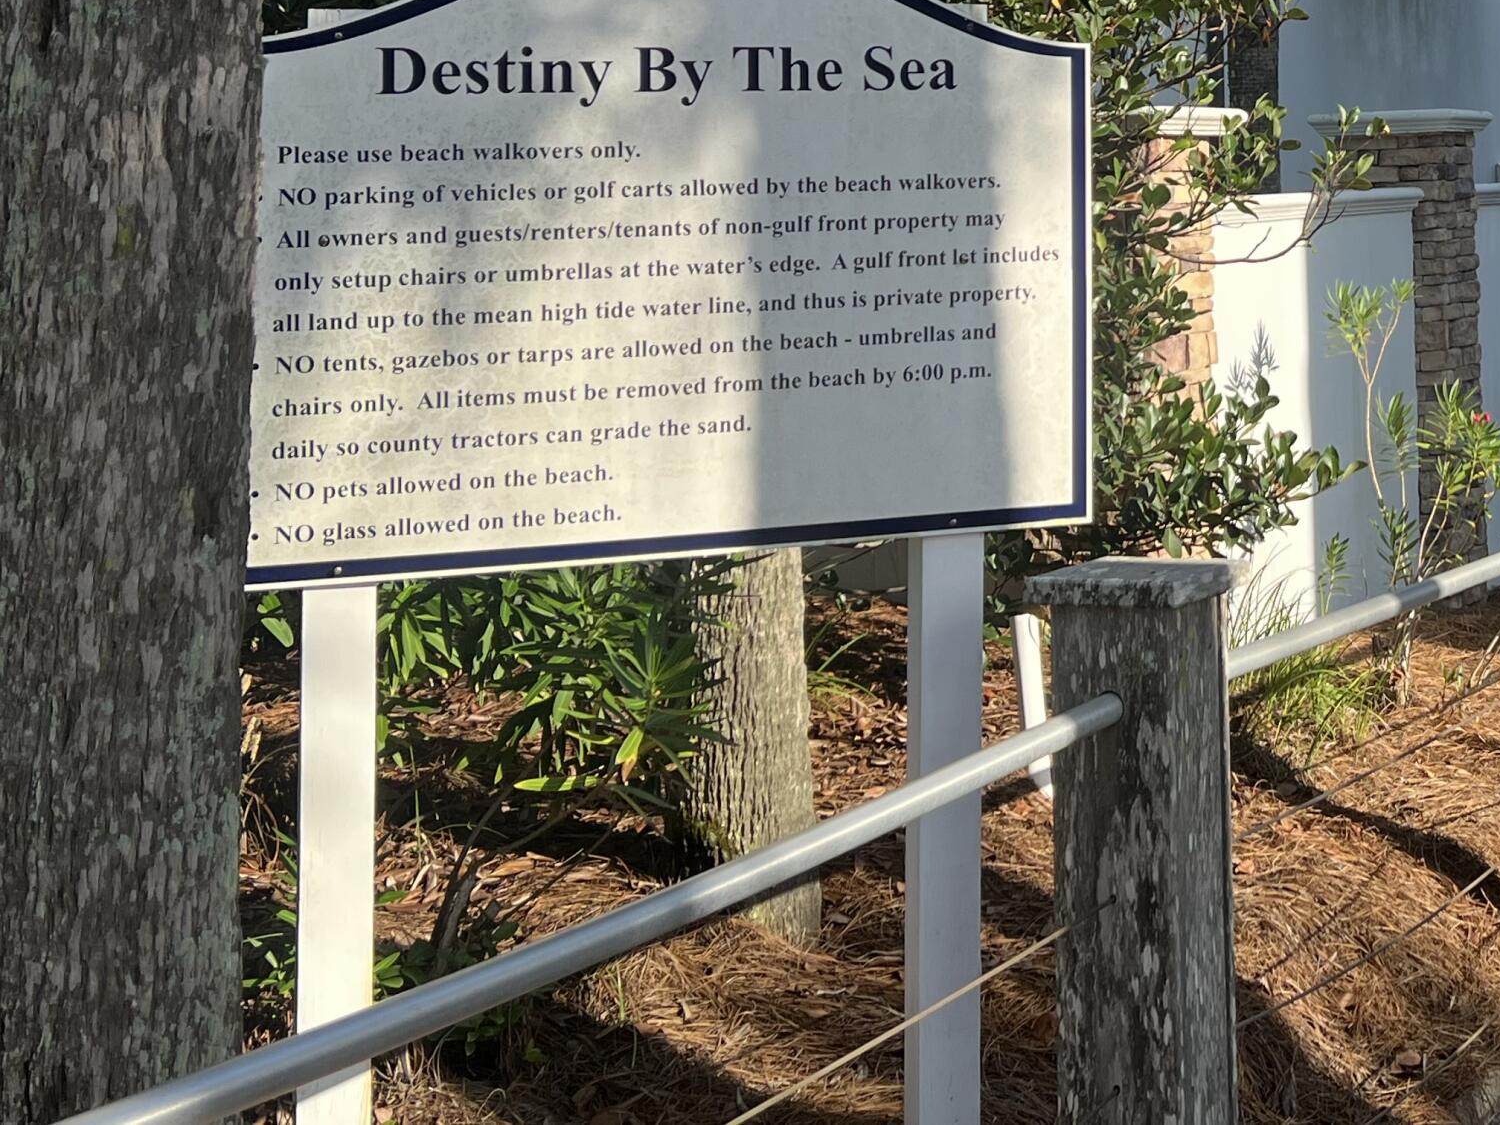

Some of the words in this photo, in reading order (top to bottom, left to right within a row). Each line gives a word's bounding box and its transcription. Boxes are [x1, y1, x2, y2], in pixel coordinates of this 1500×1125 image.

[374, 45, 614, 108] Destiny
[633, 46, 715, 107] By
[731, 46, 844, 92] The
[863, 45, 959, 92] Sea
[276, 145, 350, 165] Please
[356, 148, 393, 164] use
[399, 142, 465, 163] beach
[472, 141, 584, 162] walkovers
[590, 140, 641, 164] only.
[277, 186, 317, 208] NO
[323, 185, 416, 211] parking
[421, 183, 447, 204] of
[450, 182, 537, 203] vehicles
[543, 186, 568, 201] or
[573, 180, 617, 205] golf
[621, 181, 673, 199] carts
[679, 177, 759, 197] allowed
[765, 176, 791, 200] by
[796, 176, 829, 194] the
[834, 174, 892, 194] beach
[897, 172, 1001, 192] walkovers.
[275, 229, 312, 250] All
[317, 231, 399, 249] owners
[405, 225, 448, 245] and
[454, 220, 692, 249] guests/renters/tenants
[698, 217, 721, 236] of
[725, 214, 814, 240] non-gulf
[817, 214, 868, 233] front
[873, 212, 960, 236] property
[965, 213, 1004, 231] may
[274, 271, 324, 296] only
[331, 271, 392, 294] setup
[398, 266, 467, 287] chairs
[473, 269, 499, 284] or
[505, 261, 614, 283] umbrellas
[620, 261, 641, 279] at
[647, 259, 680, 278] the
[768, 254, 821, 278] edge.
[831, 252, 849, 271] A
[852, 250, 894, 275] gulf
[897, 249, 947, 268] front
[982, 245, 1059, 265] includes
[272, 313, 301, 333] all
[308, 311, 358, 332] land
[366, 314, 396, 334] up
[402, 310, 424, 328] to
[431, 307, 466, 327] the
[473, 309, 533, 325] mean
[541, 302, 588, 326] high
[595, 300, 636, 320] tide
[641, 300, 703, 317] water
[708, 296, 752, 316] line,
[758, 293, 797, 313] and
[803, 292, 846, 311] thus
[851, 290, 868, 308] is
[872, 288, 944, 312] private
[948, 285, 1036, 309] property.
[274, 354, 315, 376] NO
[322, 354, 385, 375] tents,
[391, 348, 480, 375] gazebos
[486, 351, 512, 366] or
[517, 346, 574, 367] tarps
[580, 346, 615, 361] are
[622, 336, 703, 358] allowed
[709, 340, 735, 354] on
[741, 334, 774, 353] the
[779, 330, 838, 351] beach
[858, 325, 956, 347] umbrellas
[961, 322, 997, 341] and
[271, 396, 343, 418] chairs
[350, 393, 404, 417] only.
[416, 390, 450, 411] All
[456, 388, 516, 408] items
[523, 386, 577, 405] must
[584, 383, 609, 401] be
[615, 376, 706, 400] removed
[713, 375, 764, 394] from
[769, 372, 803, 391] the
[808, 367, 867, 388] beach
[872, 366, 897, 389] by
[902, 362, 945, 383] 6:00
[950, 365, 992, 385] p.m.
[271, 439, 329, 463] daily
[335, 441, 360, 457] so
[366, 434, 444, 457] county
[450, 430, 539, 450] tractors
[545, 429, 583, 444] can
[590, 420, 652, 446] grade
[658, 418, 691, 437] the
[697, 414, 752, 435] sand.
[273, 481, 315, 502] NO
[322, 480, 368, 505] pets
[375, 472, 462, 496] allowed
[469, 475, 496, 490] on
[504, 468, 538, 488] the
[545, 463, 614, 485] beach.
[273, 524, 315, 545] NO
[322, 521, 377, 548] glass
[384, 513, 470, 538] allowed
[477, 516, 504, 531] on
[511, 509, 546, 528] the
[553, 503, 622, 525] beach.
